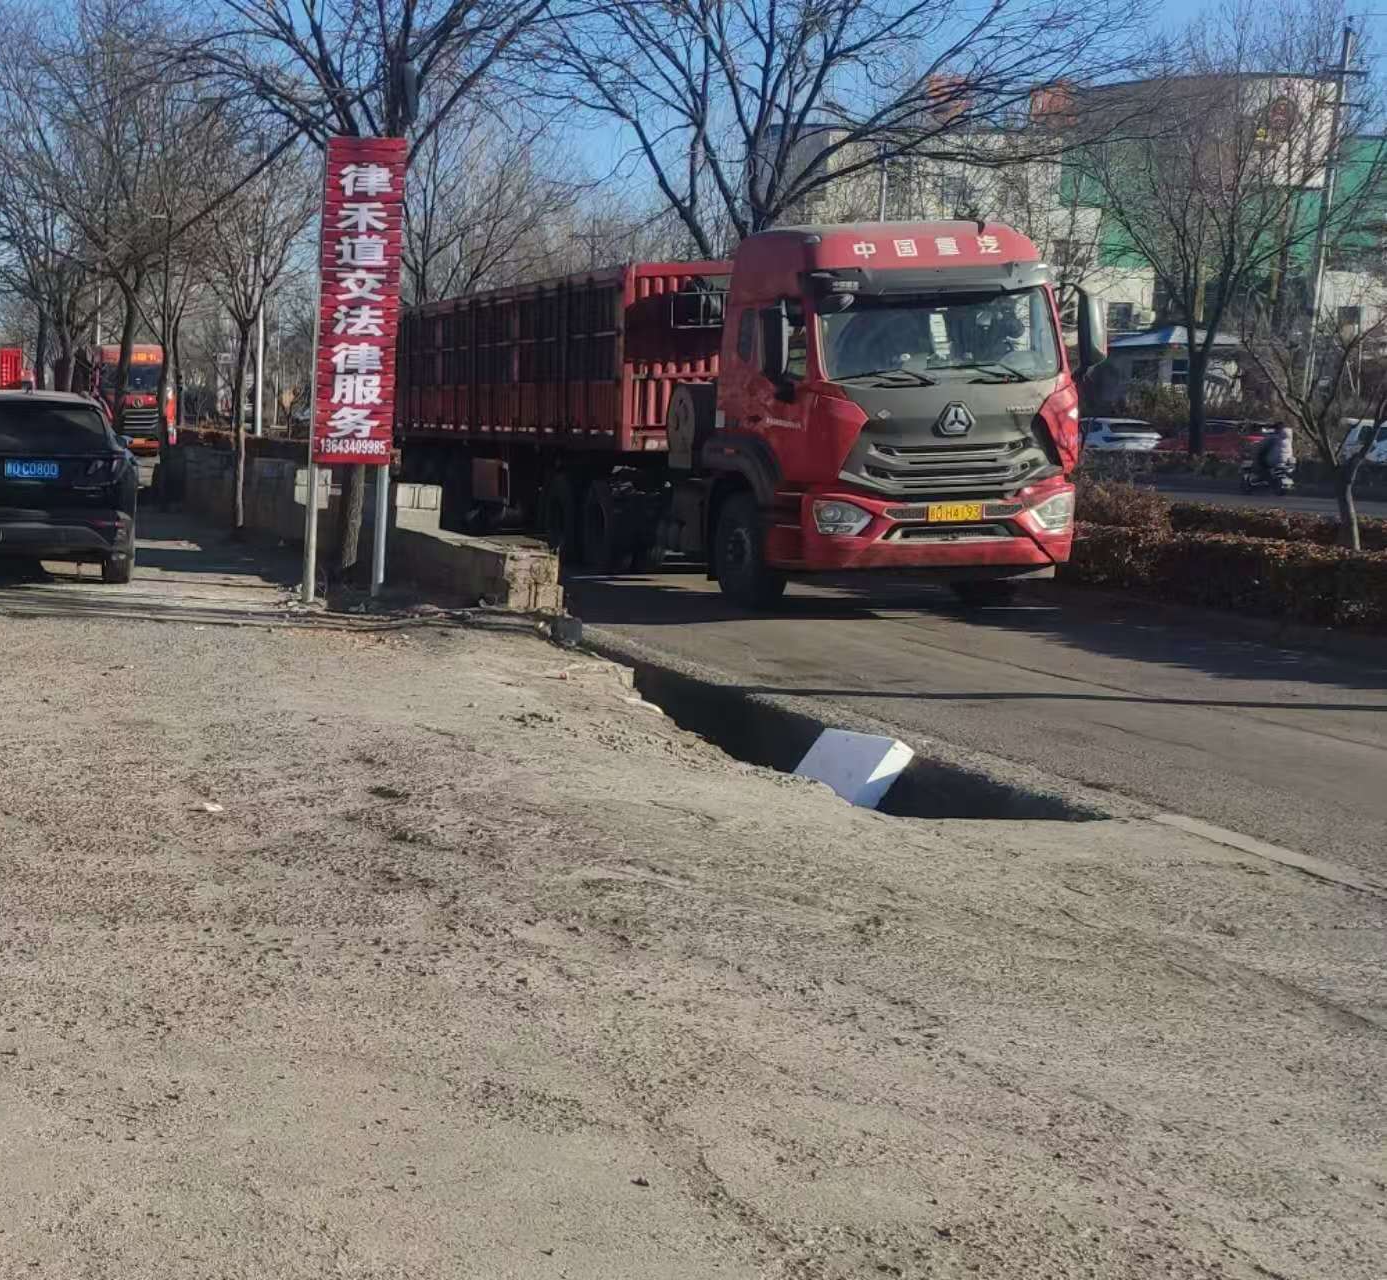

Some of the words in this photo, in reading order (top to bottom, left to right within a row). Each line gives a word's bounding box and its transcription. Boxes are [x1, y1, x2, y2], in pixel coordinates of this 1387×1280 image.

[327, 163, 392, 438] 律禾道交法律服务
[853, 235, 1002, 259] 中国重汽
